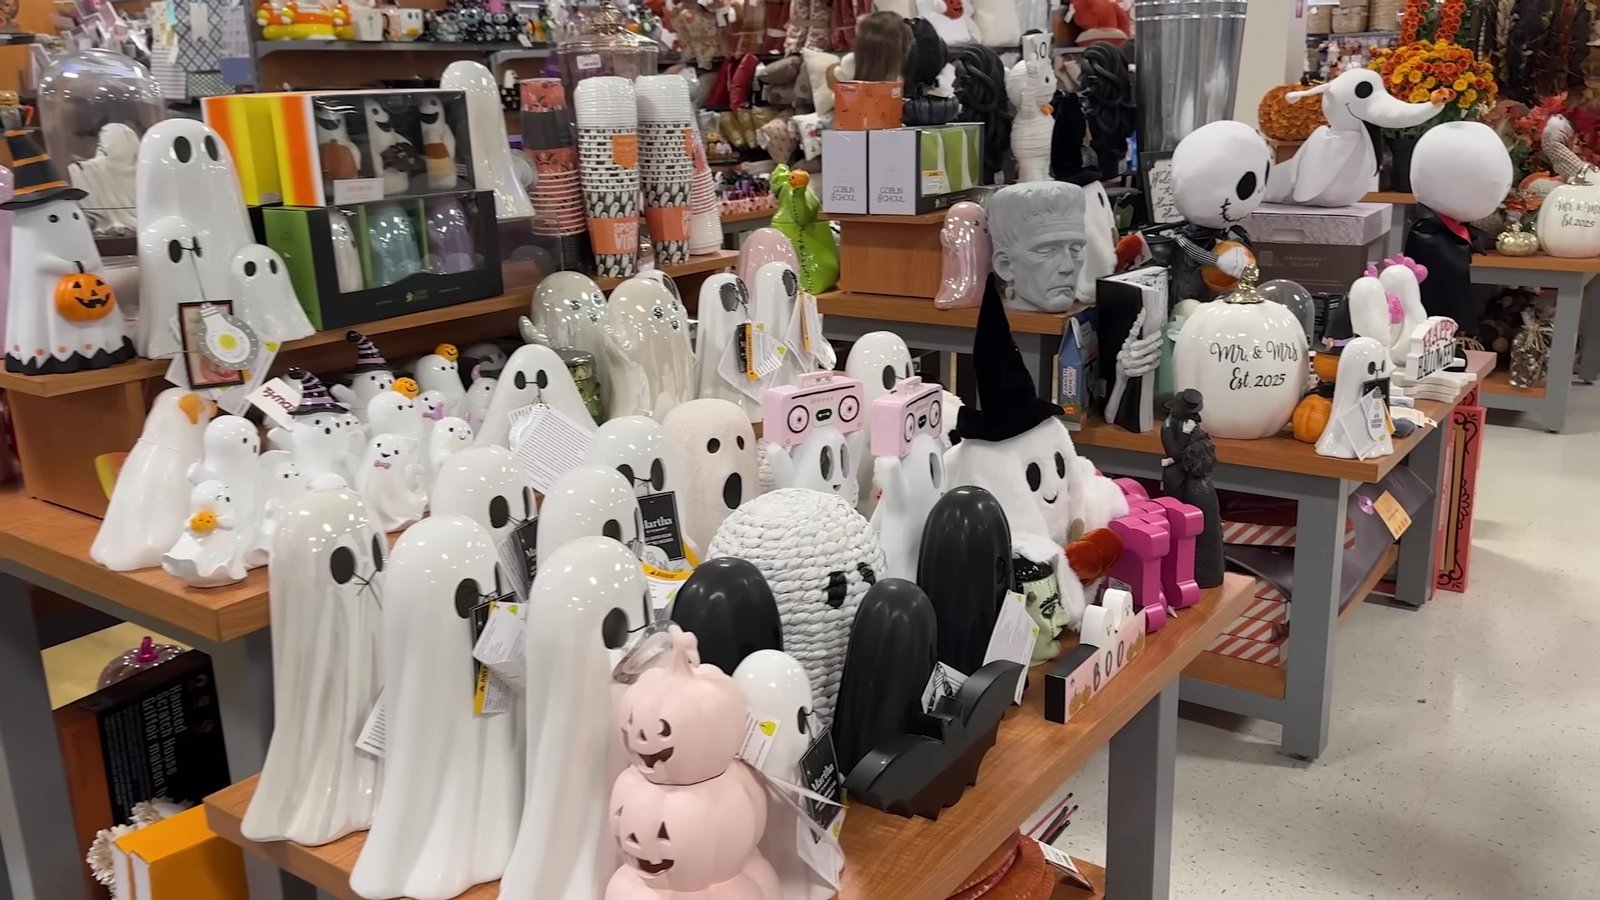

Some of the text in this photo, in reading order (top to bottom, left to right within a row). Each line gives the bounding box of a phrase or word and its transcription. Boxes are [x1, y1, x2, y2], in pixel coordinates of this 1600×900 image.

[832, 185, 855, 194] GOBLIN
[880, 186, 904, 195] GOBLIN
[1209, 342, 1249, 364] Mr.
[1252, 345, 1263, 359] &
[1229, 366, 1287, 391] Est. 2025
[1093, 640, 1125, 692] BOO
[156, 690, 172, 738] Scratch
[169, 684, 188, 734] Haunted
[148, 742, 165, 787] maison
[162, 737, 178, 776] House
